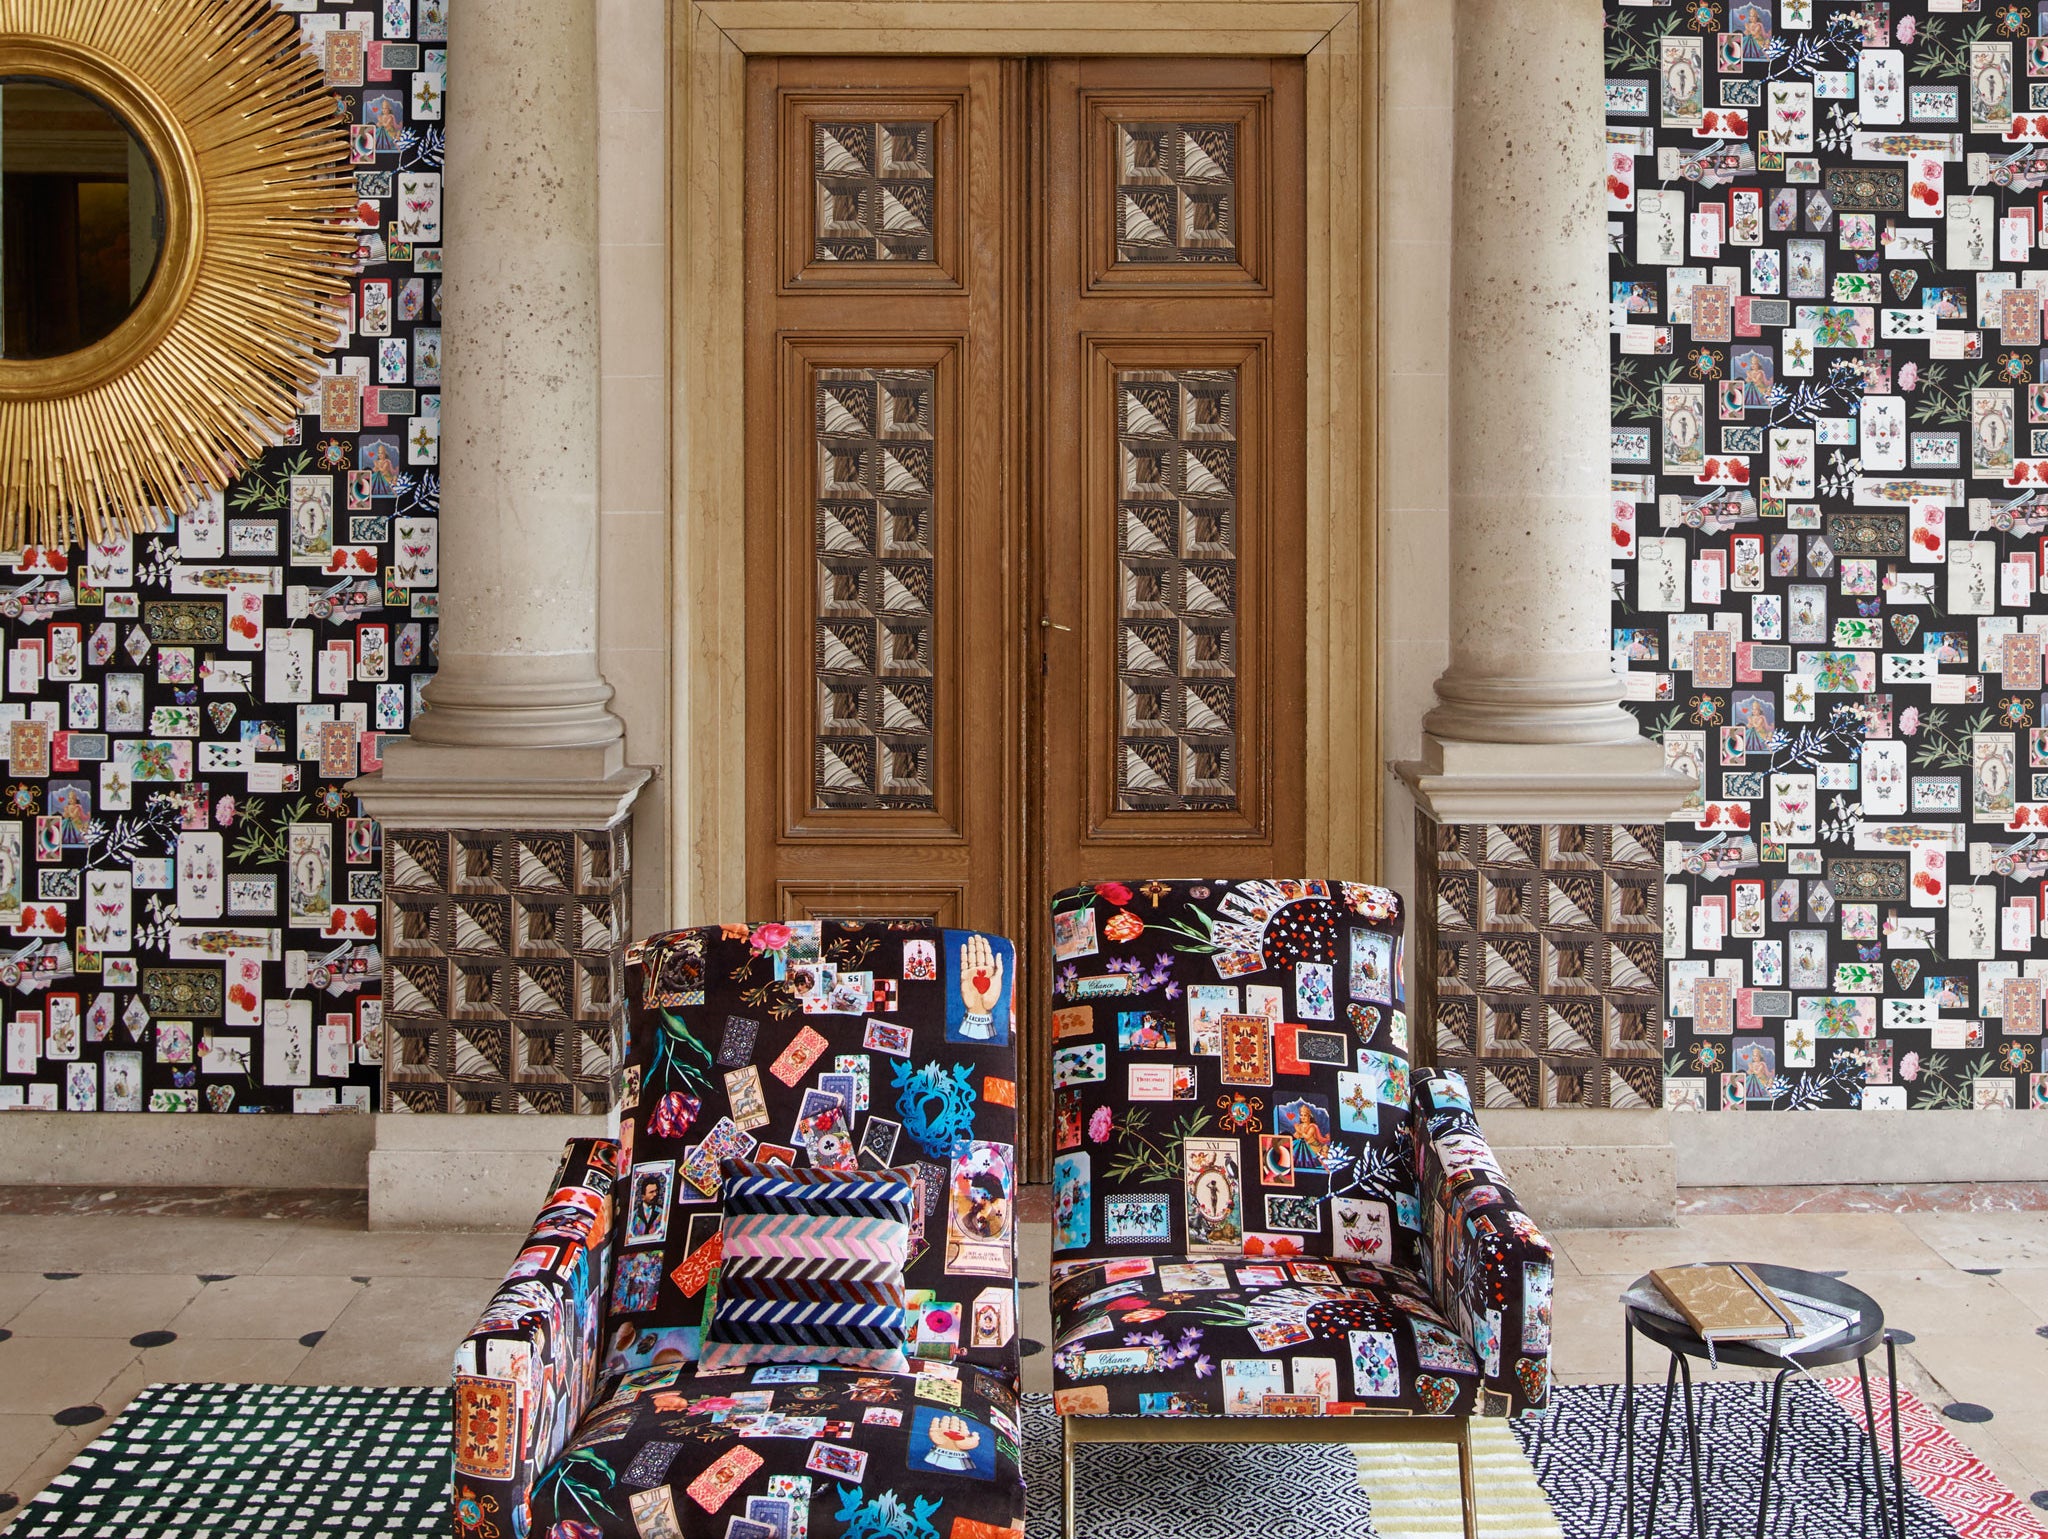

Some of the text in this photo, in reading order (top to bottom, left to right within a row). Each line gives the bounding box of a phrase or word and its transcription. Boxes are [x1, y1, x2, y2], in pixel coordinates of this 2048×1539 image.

[1088, 980, 1114, 989] Chance
[731, 1069, 750, 1079] VIII
[1206, 1142, 1220, 1150] XXI
[1099, 1353, 1133, 1364] Chance
[638, 1489, 662, 1503] VIII
